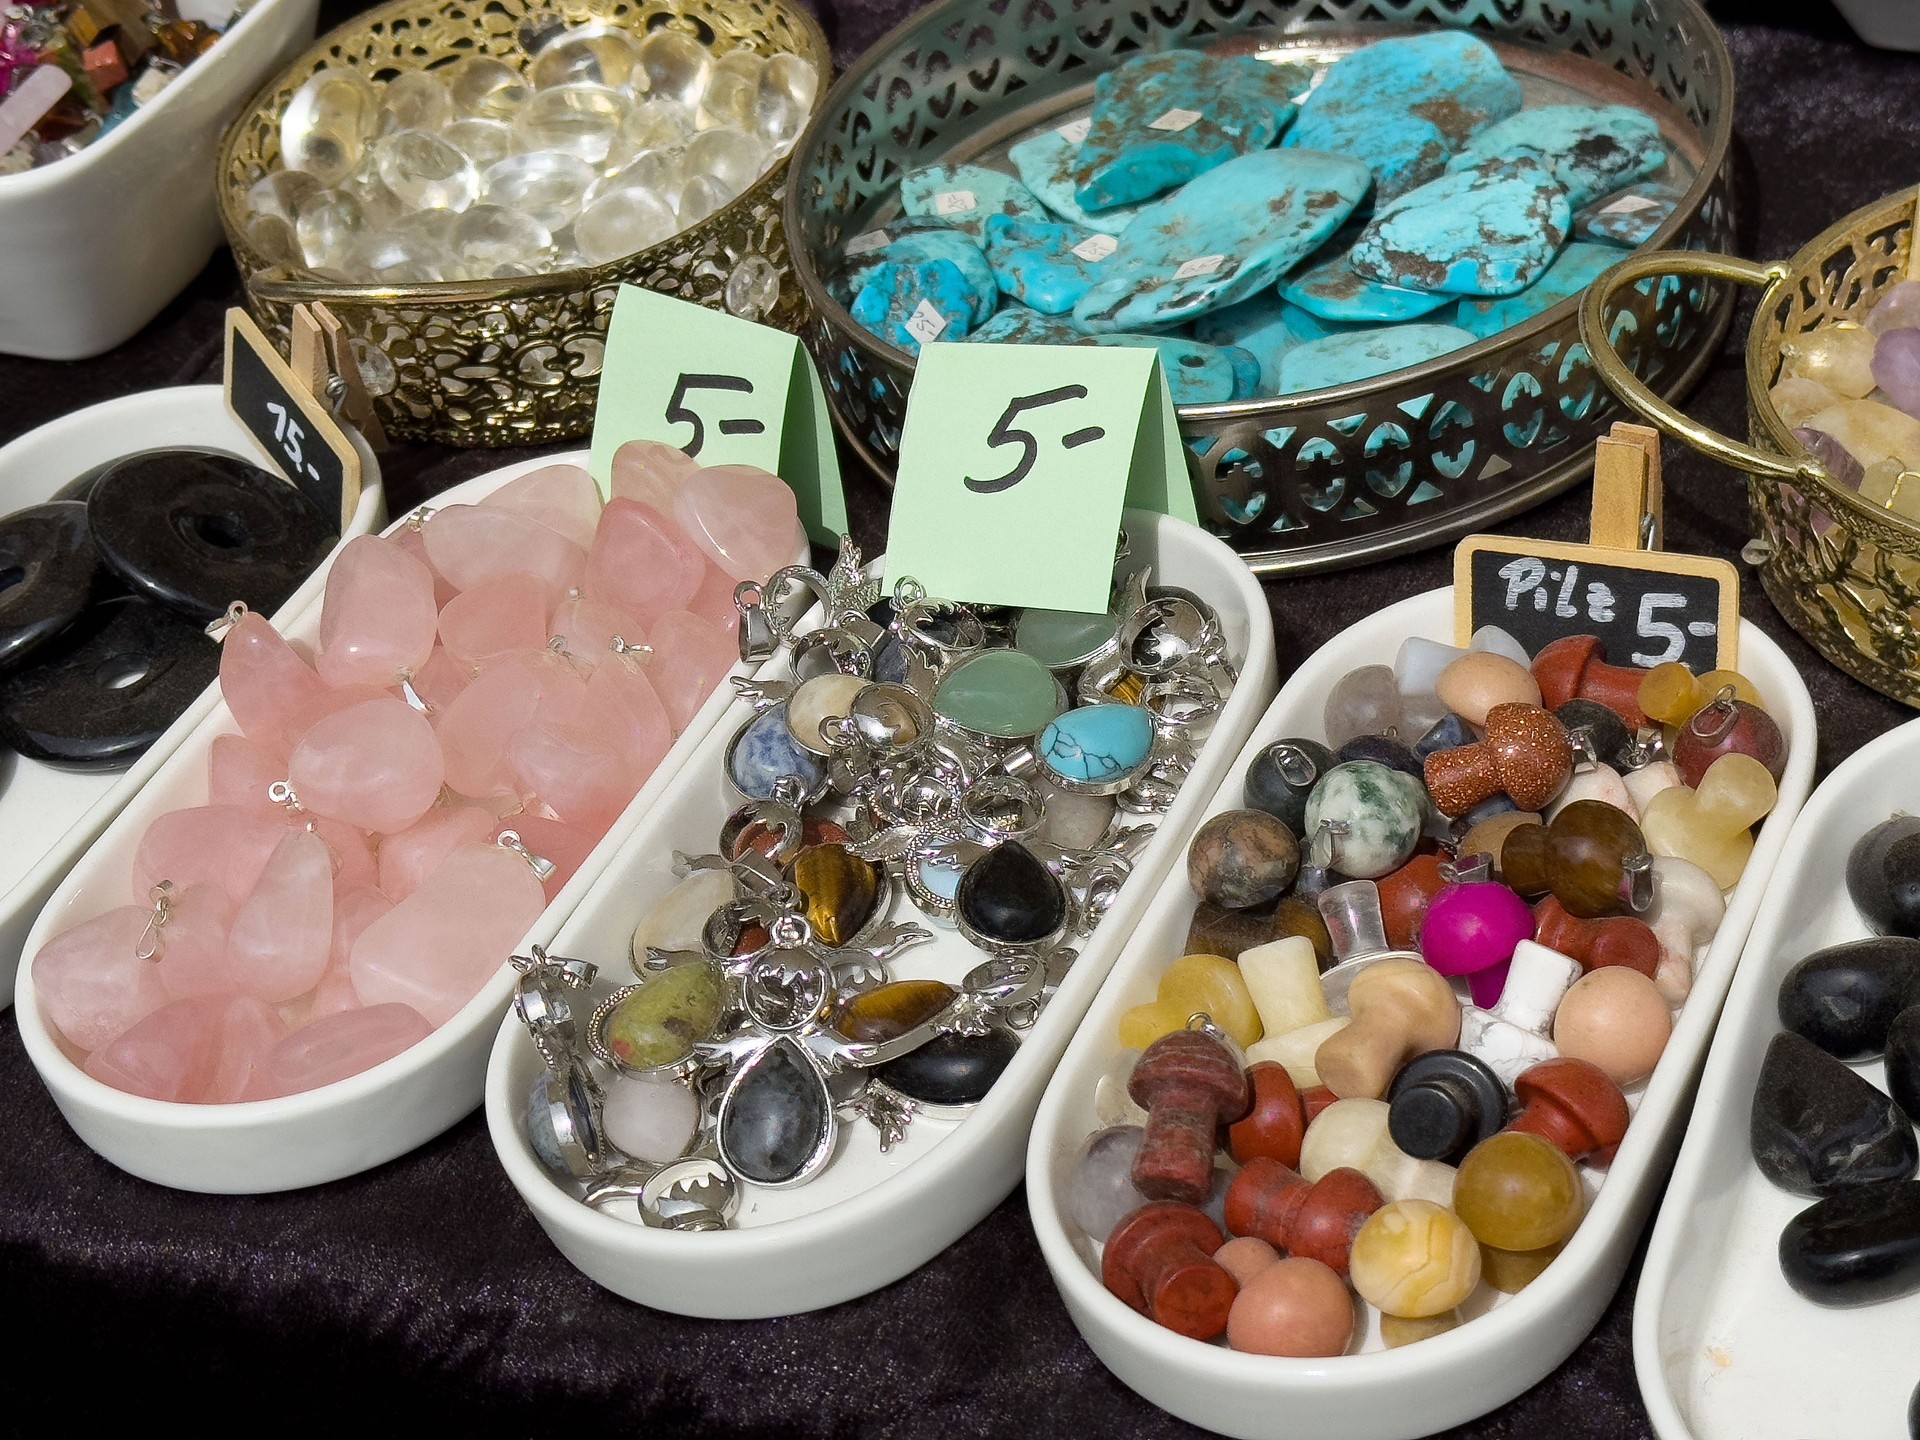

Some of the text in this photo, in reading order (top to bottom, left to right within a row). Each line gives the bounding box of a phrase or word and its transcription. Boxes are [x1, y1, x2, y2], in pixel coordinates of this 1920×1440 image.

[664, 372, 766, 459] 5-
[963, 384, 1106, 494] 5-
[1631, 592, 1716, 668] 5-
